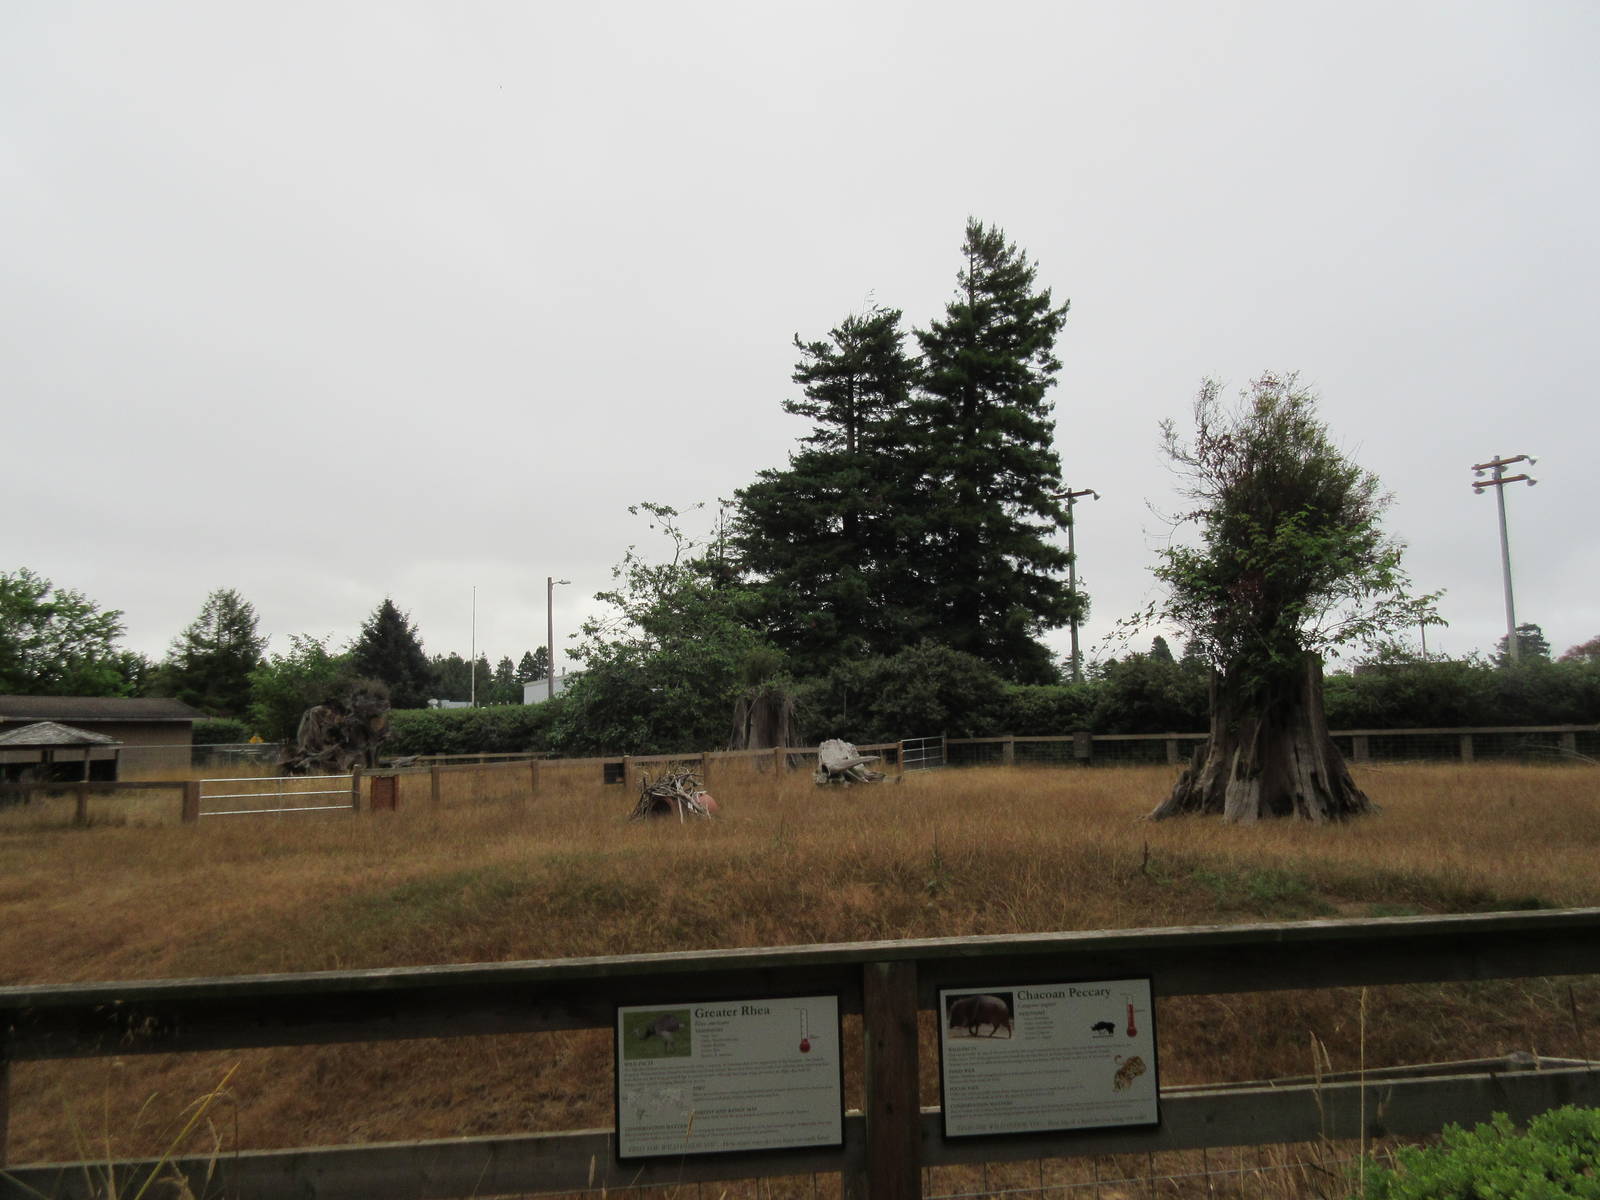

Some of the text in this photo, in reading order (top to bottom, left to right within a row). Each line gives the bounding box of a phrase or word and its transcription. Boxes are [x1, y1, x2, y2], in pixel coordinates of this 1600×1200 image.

[1017, 987, 1111, 1000] Chacoan Peccary
[694, 1005, 770, 1018] Greater Rhea
